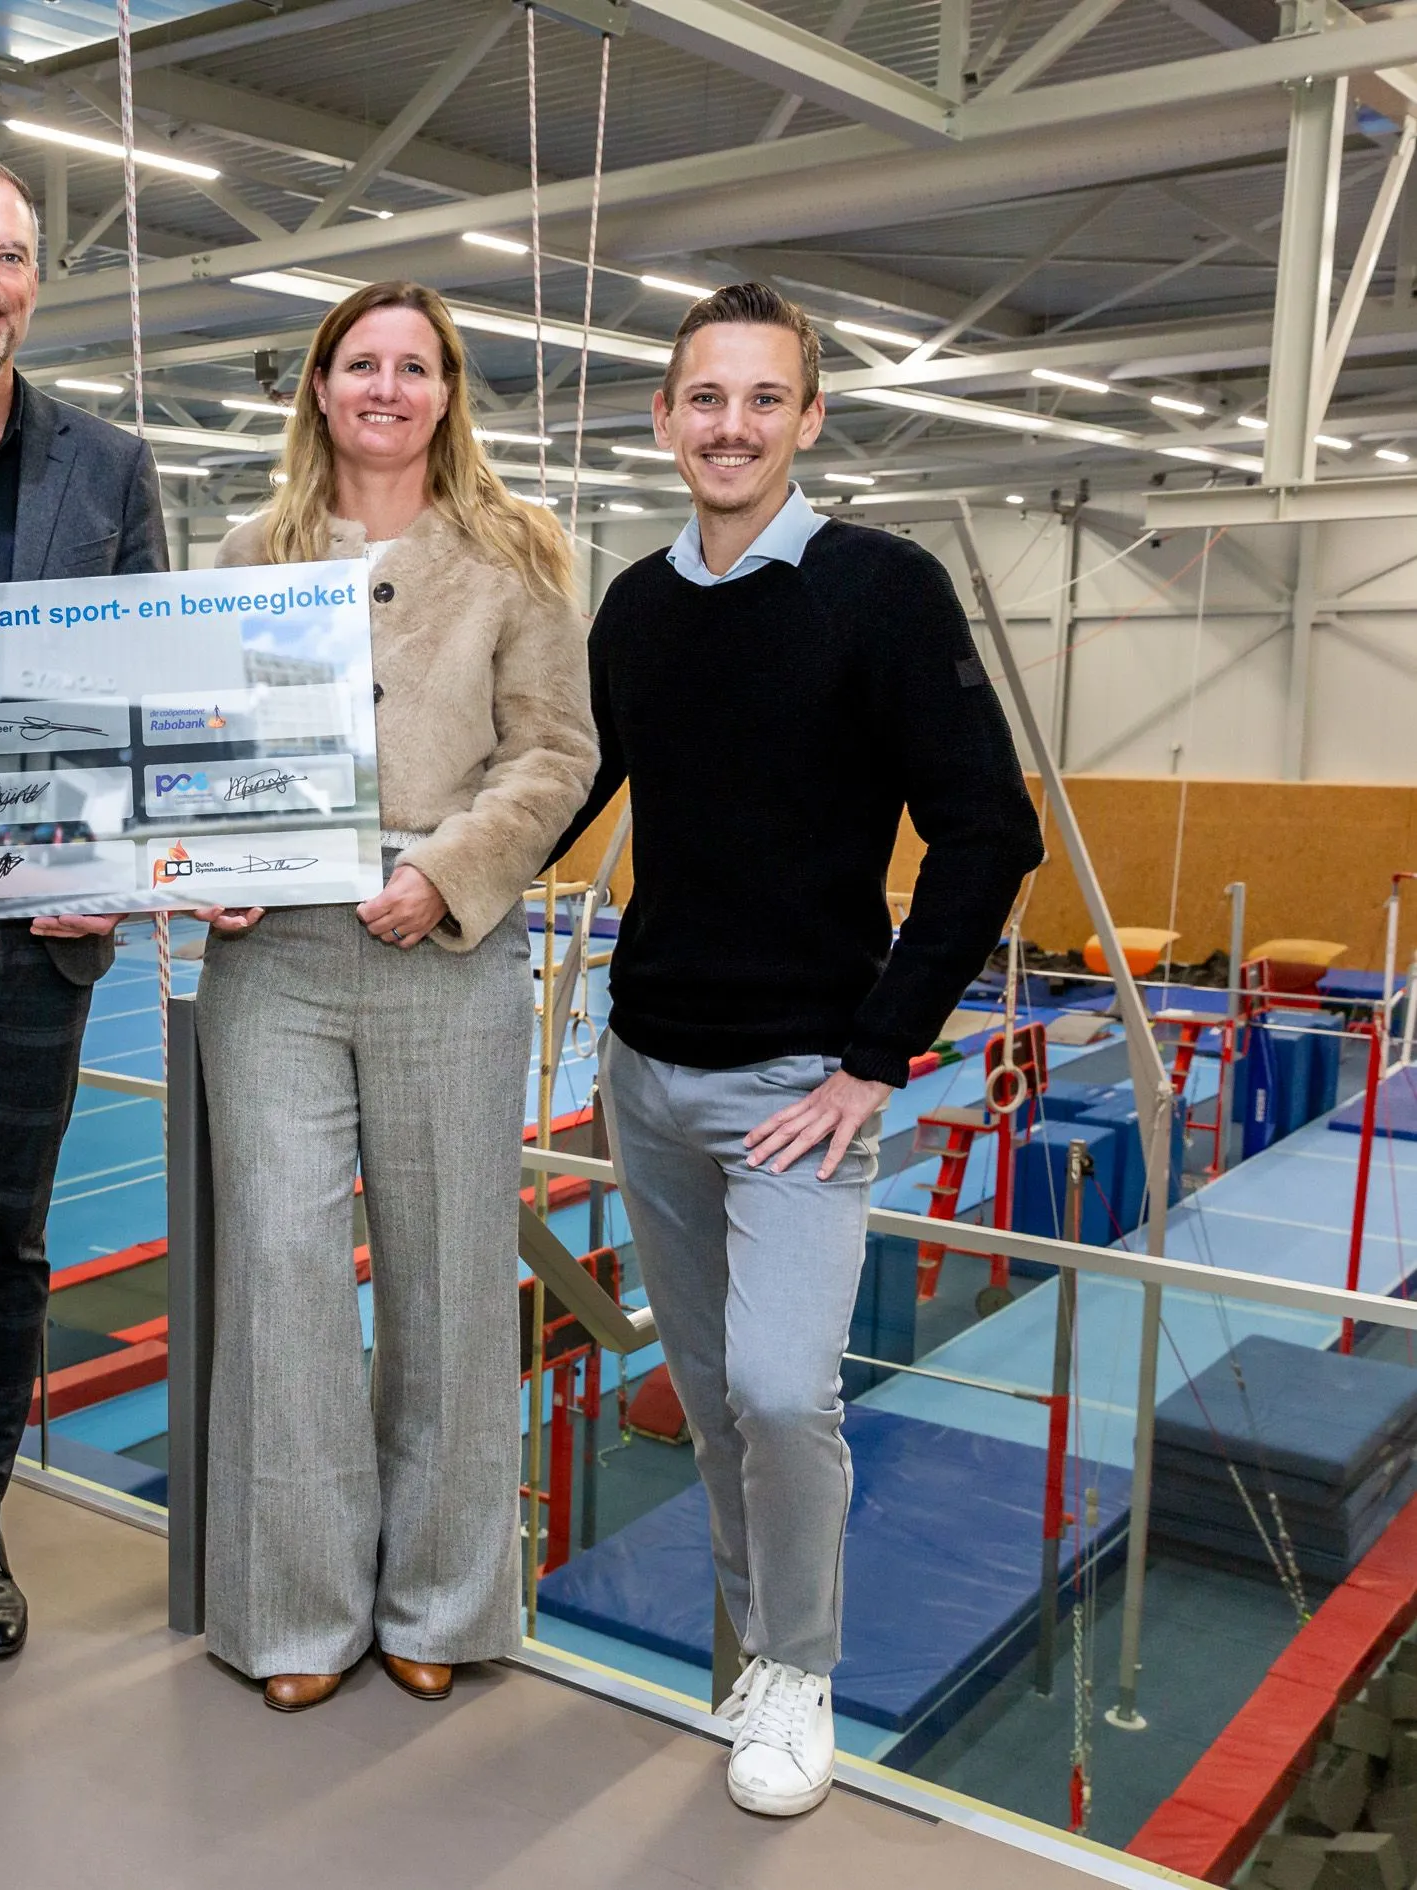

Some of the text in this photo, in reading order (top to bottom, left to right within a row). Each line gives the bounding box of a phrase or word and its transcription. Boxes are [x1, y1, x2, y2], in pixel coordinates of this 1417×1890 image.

[49, 600, 130, 628] sport-
[138, 600, 171, 618] en
[181, 584, 356, 615] beweegloket
[150, 718, 205, 731] Rabobank
